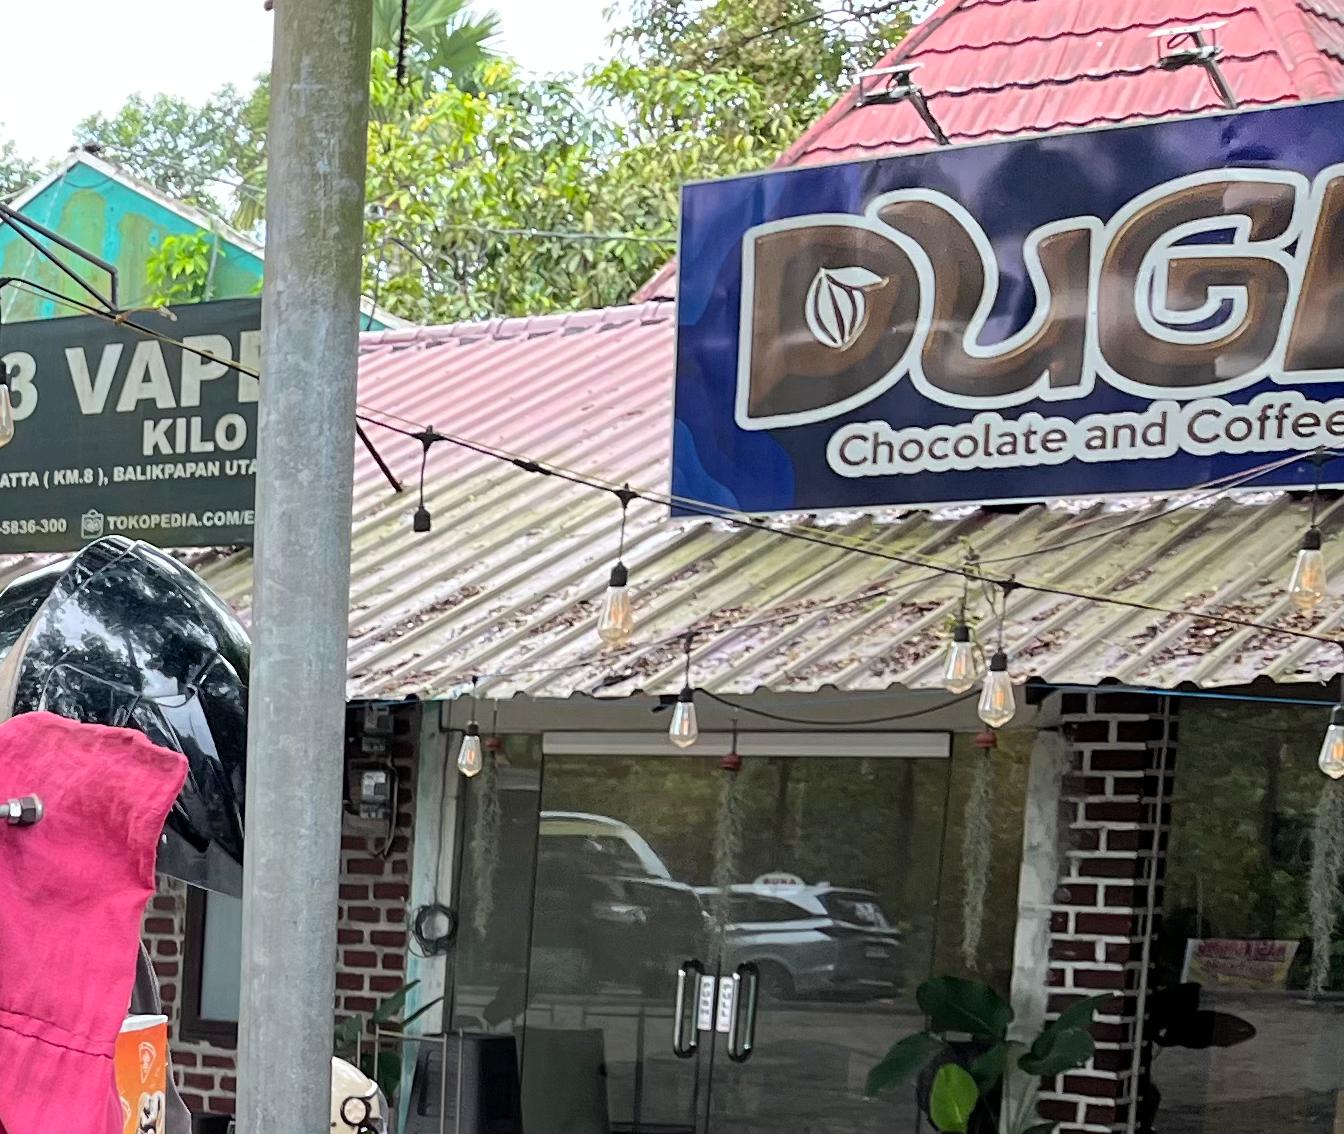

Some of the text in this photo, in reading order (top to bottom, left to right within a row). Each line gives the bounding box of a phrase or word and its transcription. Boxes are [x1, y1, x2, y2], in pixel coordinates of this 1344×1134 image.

[142, 413, 248, 456] KILO
[838, 422, 1067, 468] Chocolate
[1085, 412, 1167, 451] and
[112, 460, 220, 482] BALIKPAPAN
